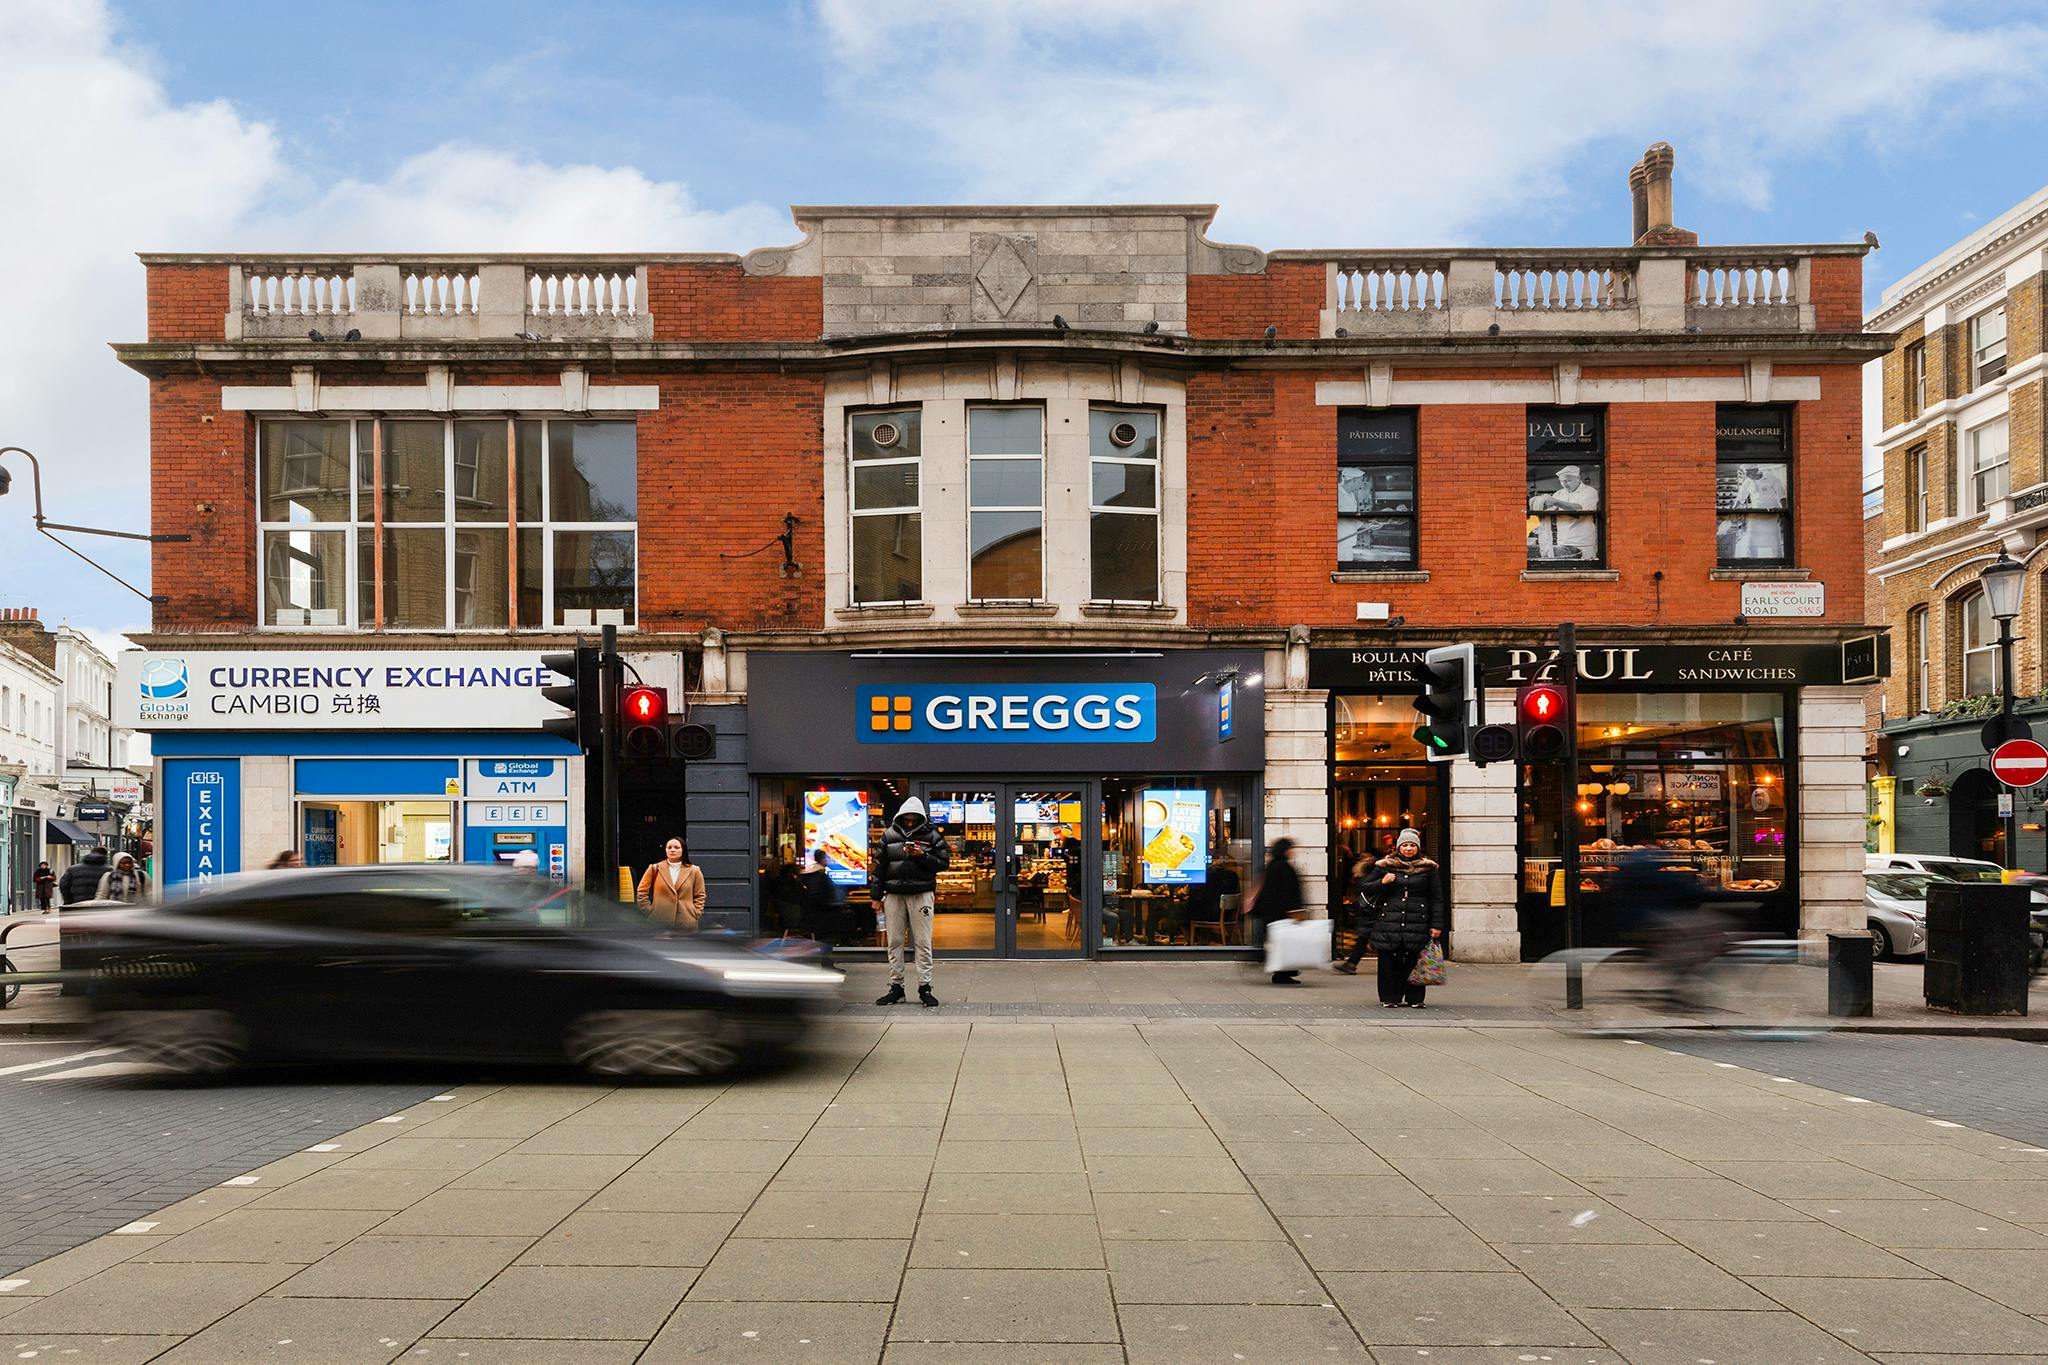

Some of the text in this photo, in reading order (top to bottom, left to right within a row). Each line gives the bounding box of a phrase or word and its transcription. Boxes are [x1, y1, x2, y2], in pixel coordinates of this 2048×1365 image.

[1349, 430, 1400, 439] PÂTISSERIE
[1528, 423, 1592, 437] PAUL
[1745, 596, 1821, 605] EARLS COURT
[1745, 607, 1778, 615] ROAD
[1351, 652, 1425, 664] BOULAN
[1708, 647, 1753, 662] CAFÉ
[210, 667, 553, 688] CURRENCY EXCHANGE
[1678, 667, 1796, 680] SANDWICHES
[140, 702, 189, 712] Global
[211, 694, 319, 714] CAMBIO
[140, 712, 189, 721] Exchange
[926, 695, 1142, 730] GREGGS
[497, 781, 536, 793] ATM
[490, 809, 543, 818] £ £ £
